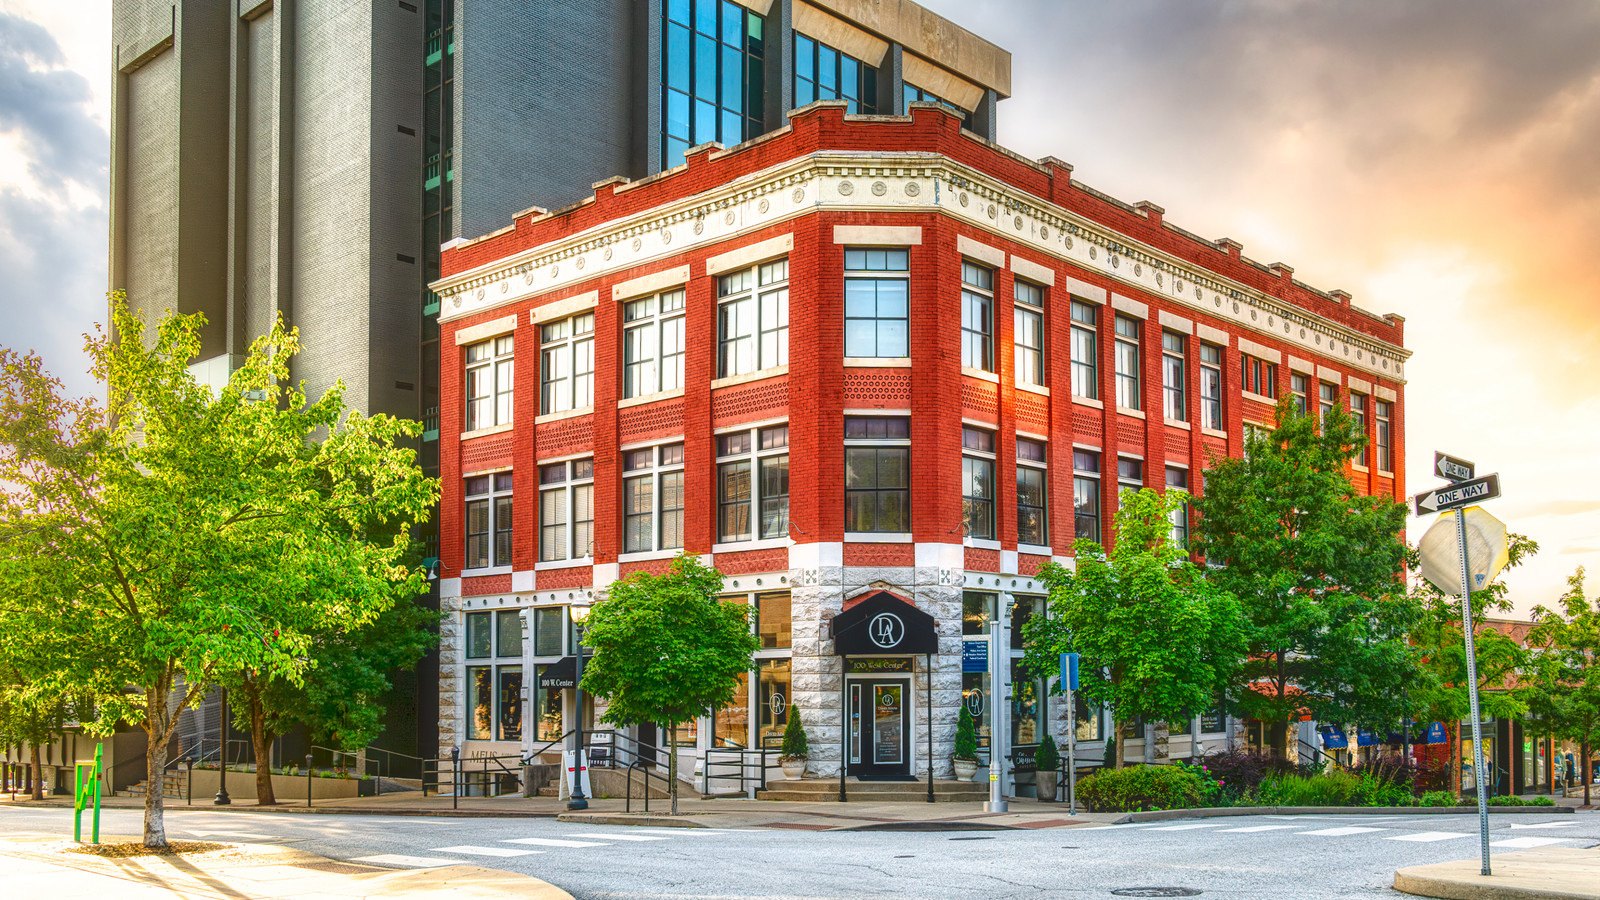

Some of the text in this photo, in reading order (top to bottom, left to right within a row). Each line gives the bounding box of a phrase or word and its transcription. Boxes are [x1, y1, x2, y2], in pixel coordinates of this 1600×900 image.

[1446, 462, 1468, 478] ONE WAY
[1437, 483, 1484, 504] ONE WAY
[541, 679, 550, 687] 100
[555, 679, 574, 687] Center
